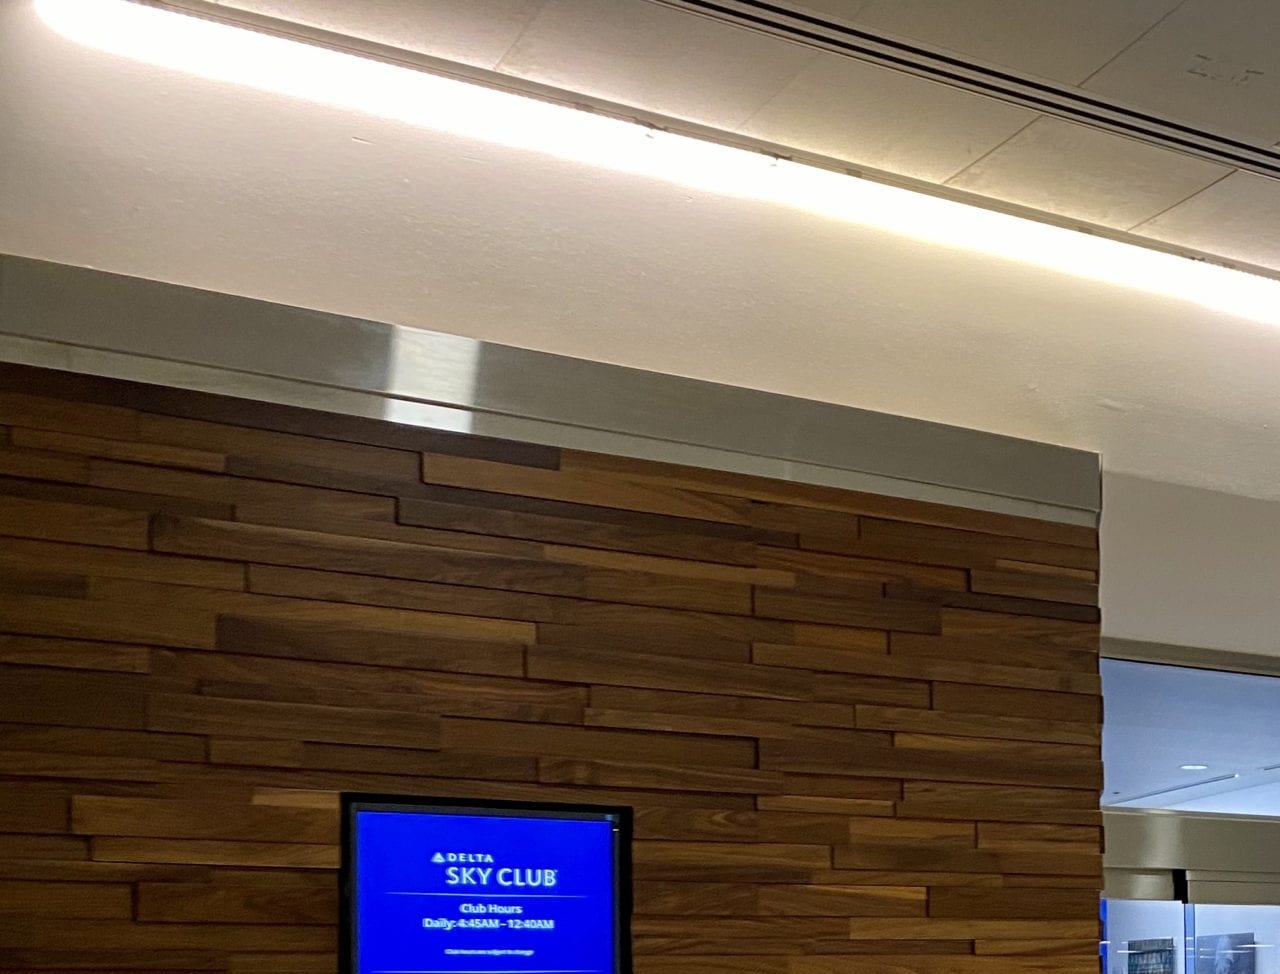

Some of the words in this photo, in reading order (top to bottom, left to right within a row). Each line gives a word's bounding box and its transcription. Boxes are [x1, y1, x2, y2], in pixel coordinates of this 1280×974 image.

[447, 853, 494, 863] DELTA
[446, 867, 493, 885] SKY
[496, 868, 557, 887] CLUB
[459, 903, 486, 914] Club
[488, 904, 523, 914] Hours
[423, 918, 457, 930] Daily:
[457, 919, 500, 928] 4:45AM
[507, 919, 555, 929] 12:40AM
